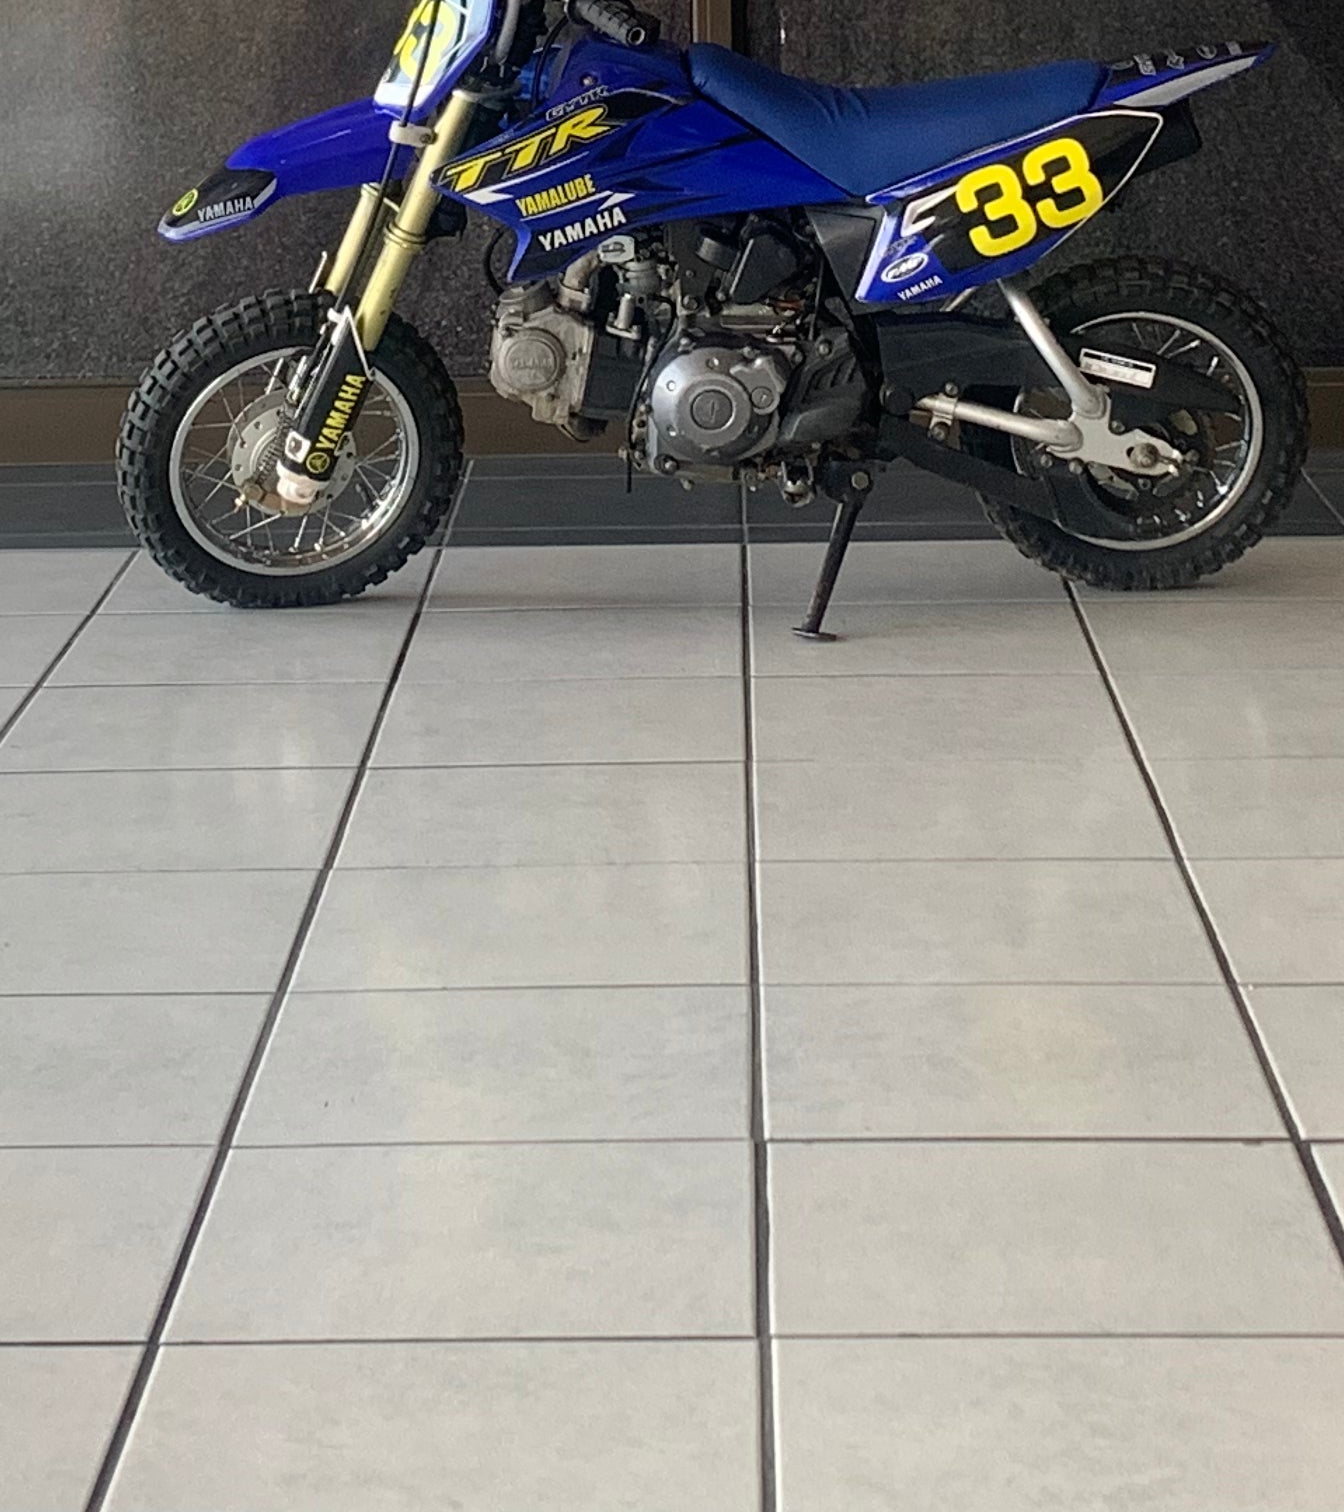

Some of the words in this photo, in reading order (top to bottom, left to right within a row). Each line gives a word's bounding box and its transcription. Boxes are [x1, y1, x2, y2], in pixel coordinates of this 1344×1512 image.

[446, 105, 611, 192] TTR
[197, 196, 253, 222] YAMAHA
[515, 174, 596, 217] YAMALUBE
[955, 138, 1104, 257] 33
[538, 206, 627, 252] YAMAHA
[897, 275, 943, 301] YAMAHA
[315, 374, 367, 449] YAMAHA
